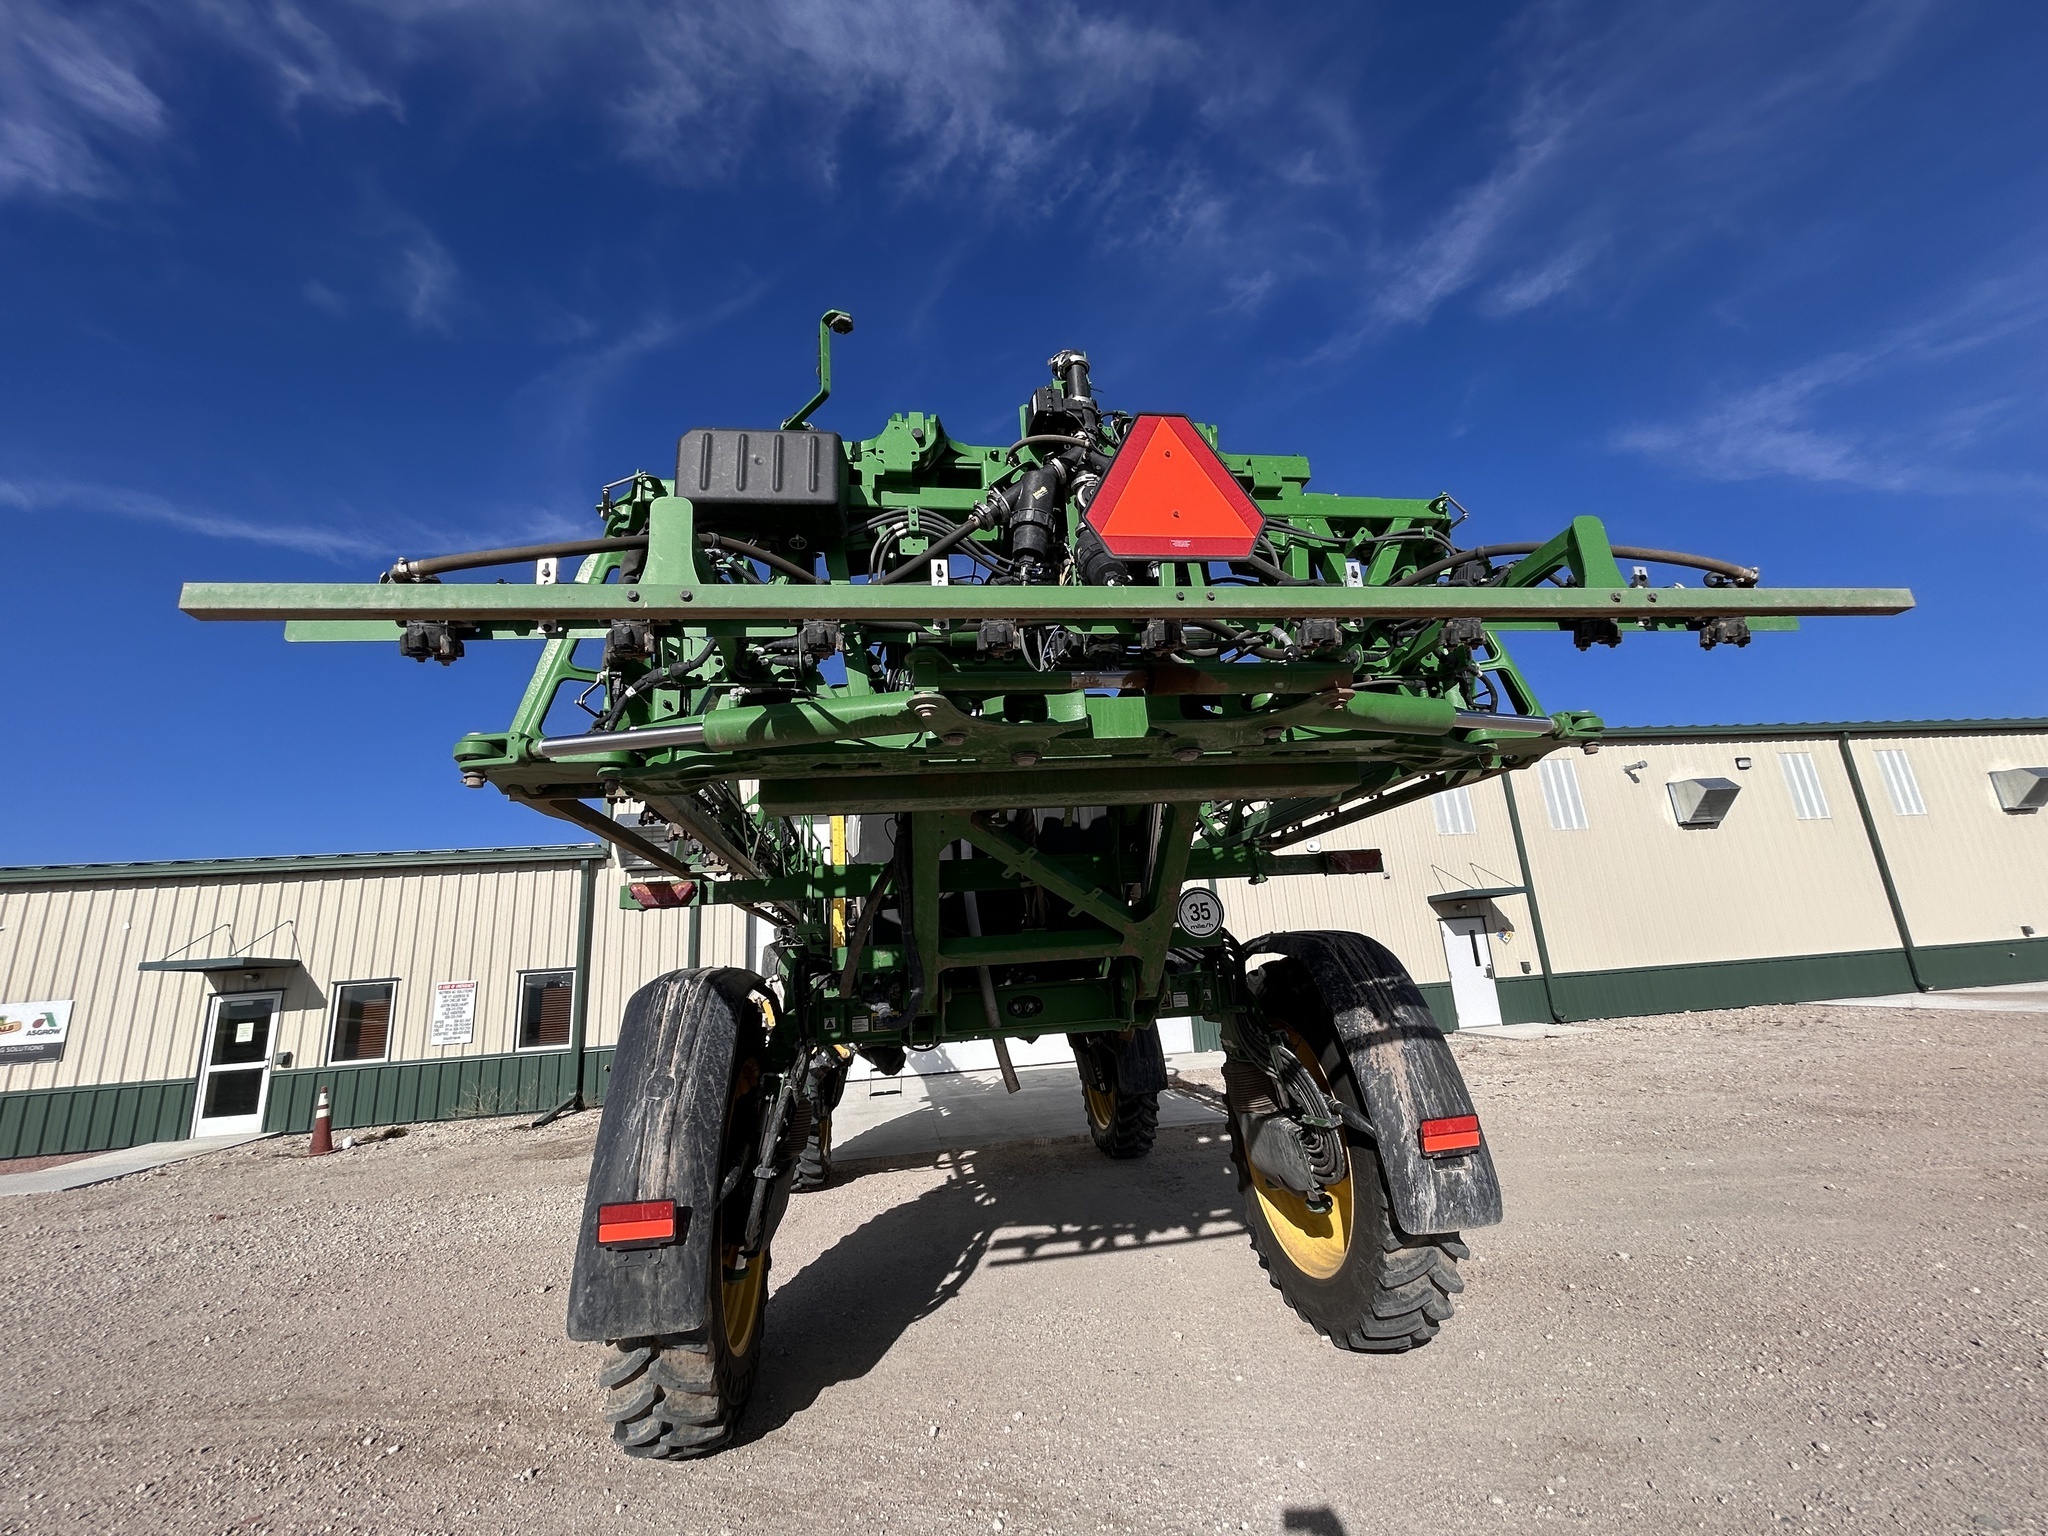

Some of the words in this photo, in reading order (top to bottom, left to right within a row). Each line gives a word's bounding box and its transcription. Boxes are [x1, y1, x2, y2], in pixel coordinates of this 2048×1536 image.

[1189, 902, 1211, 921] 35
[26, 1028, 62, 1036] ASGROW
[6, 1045, 44, 1053] SOLUTIONS
